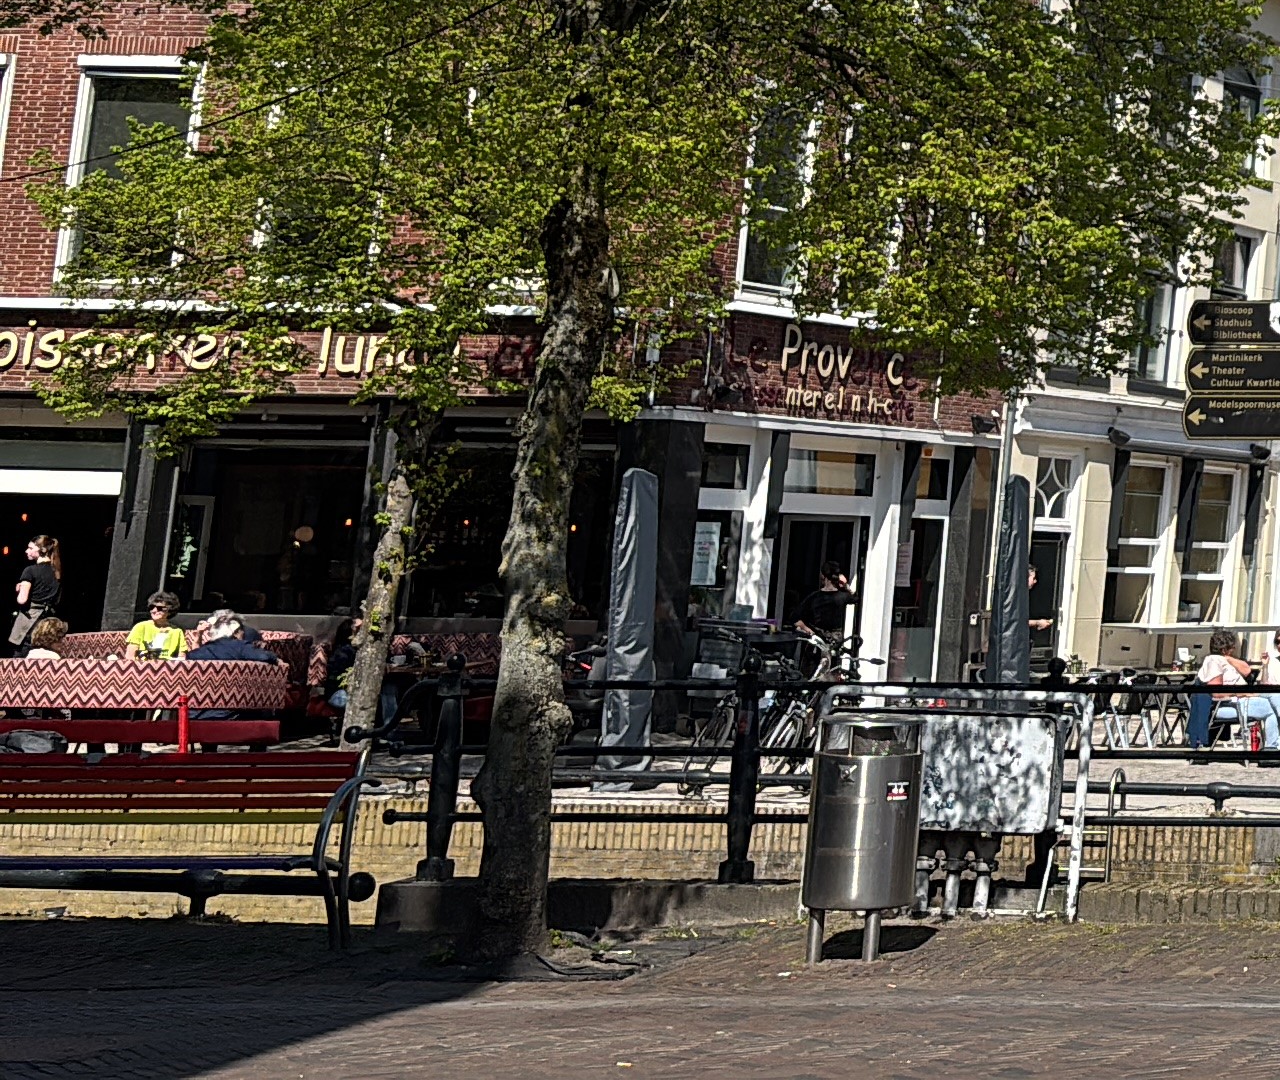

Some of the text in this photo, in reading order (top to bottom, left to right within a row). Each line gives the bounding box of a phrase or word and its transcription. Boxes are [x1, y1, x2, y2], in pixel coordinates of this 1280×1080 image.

[1214, 305, 1253, 315] Bioscoop
[1214, 318, 1253, 327] Stadhuis
[1213, 330, 1262, 339] Bibliotheek
[1211, 353, 1263, 362] Martinikerk
[1212, 366, 1246, 375] Theater
[1210, 378, 1244, 387] Cultuur
